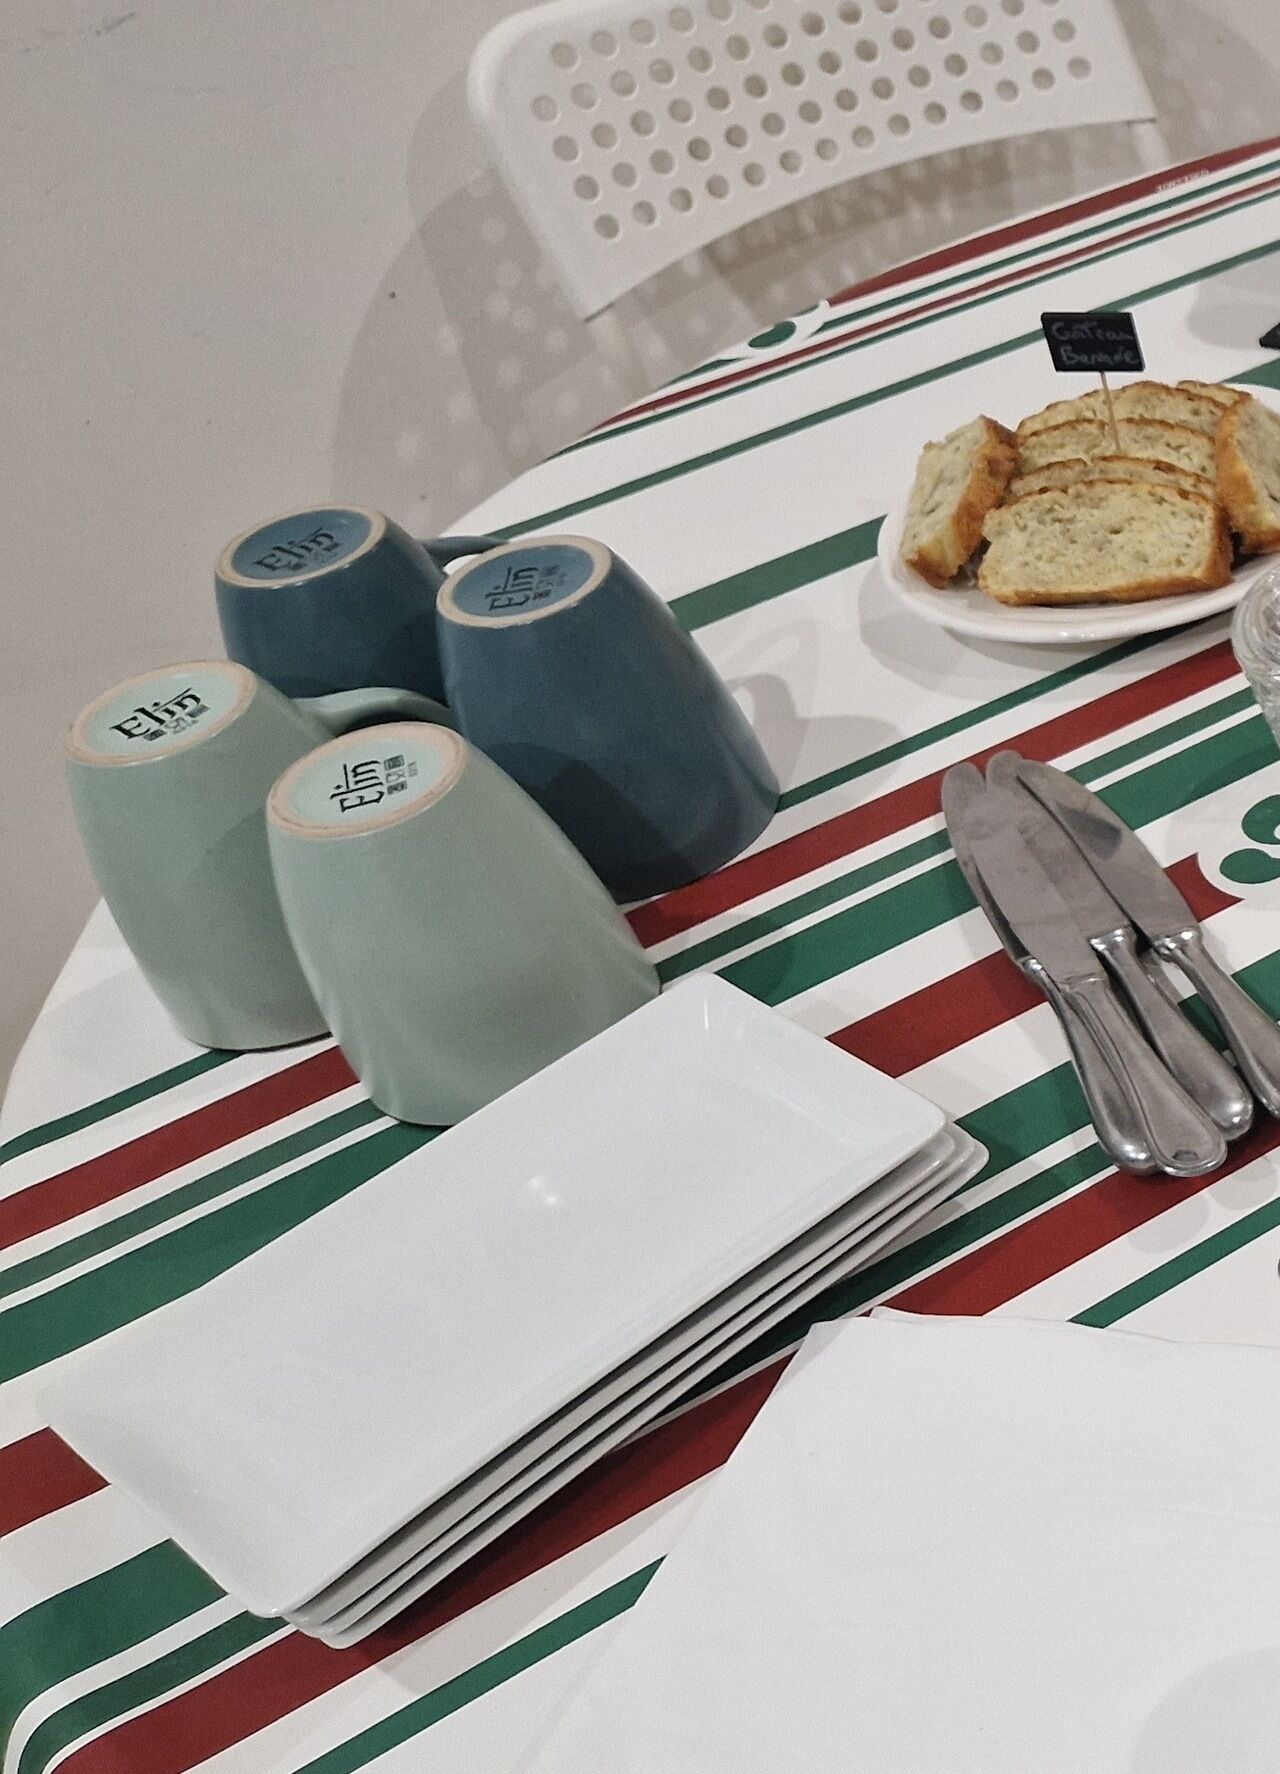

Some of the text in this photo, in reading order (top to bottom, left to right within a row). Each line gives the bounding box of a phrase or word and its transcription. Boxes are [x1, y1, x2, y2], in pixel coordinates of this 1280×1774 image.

[253, 527, 337, 571] Elin
[485, 566, 540, 612] Elin
[107, 686, 201, 740] Elin
[329, 758, 385, 813] Elin
